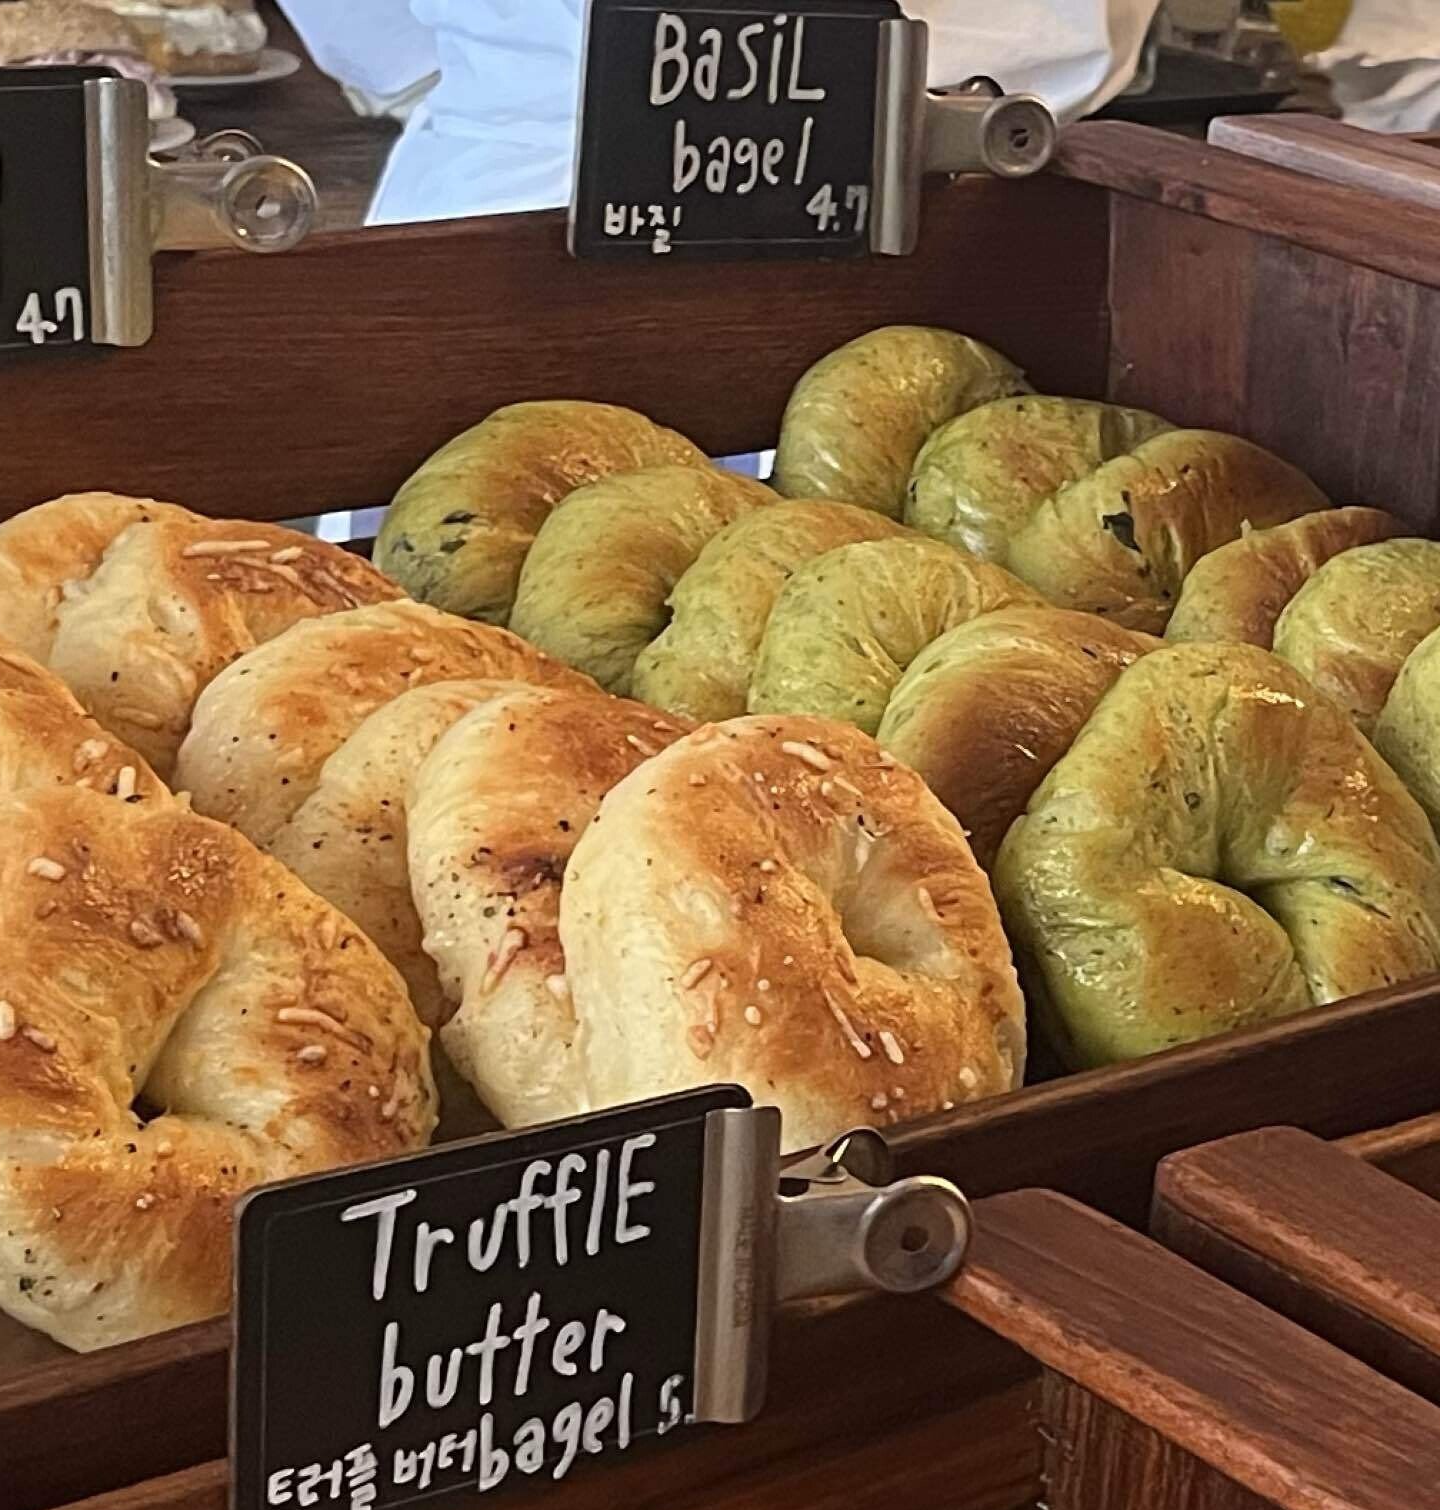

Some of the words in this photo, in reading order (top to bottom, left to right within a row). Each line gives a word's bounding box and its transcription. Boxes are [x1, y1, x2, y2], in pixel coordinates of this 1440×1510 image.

[672, 116, 814, 194] bagel
[603, 202, 682, 255] 바질
[805, 183, 868, 232] 4.7
[378, 1291, 626, 1429] butter
[393, 1428, 477, 1490] 버터
[478, 1372, 632, 1492] bagel
[658, 1374, 696, 1434] 5.
